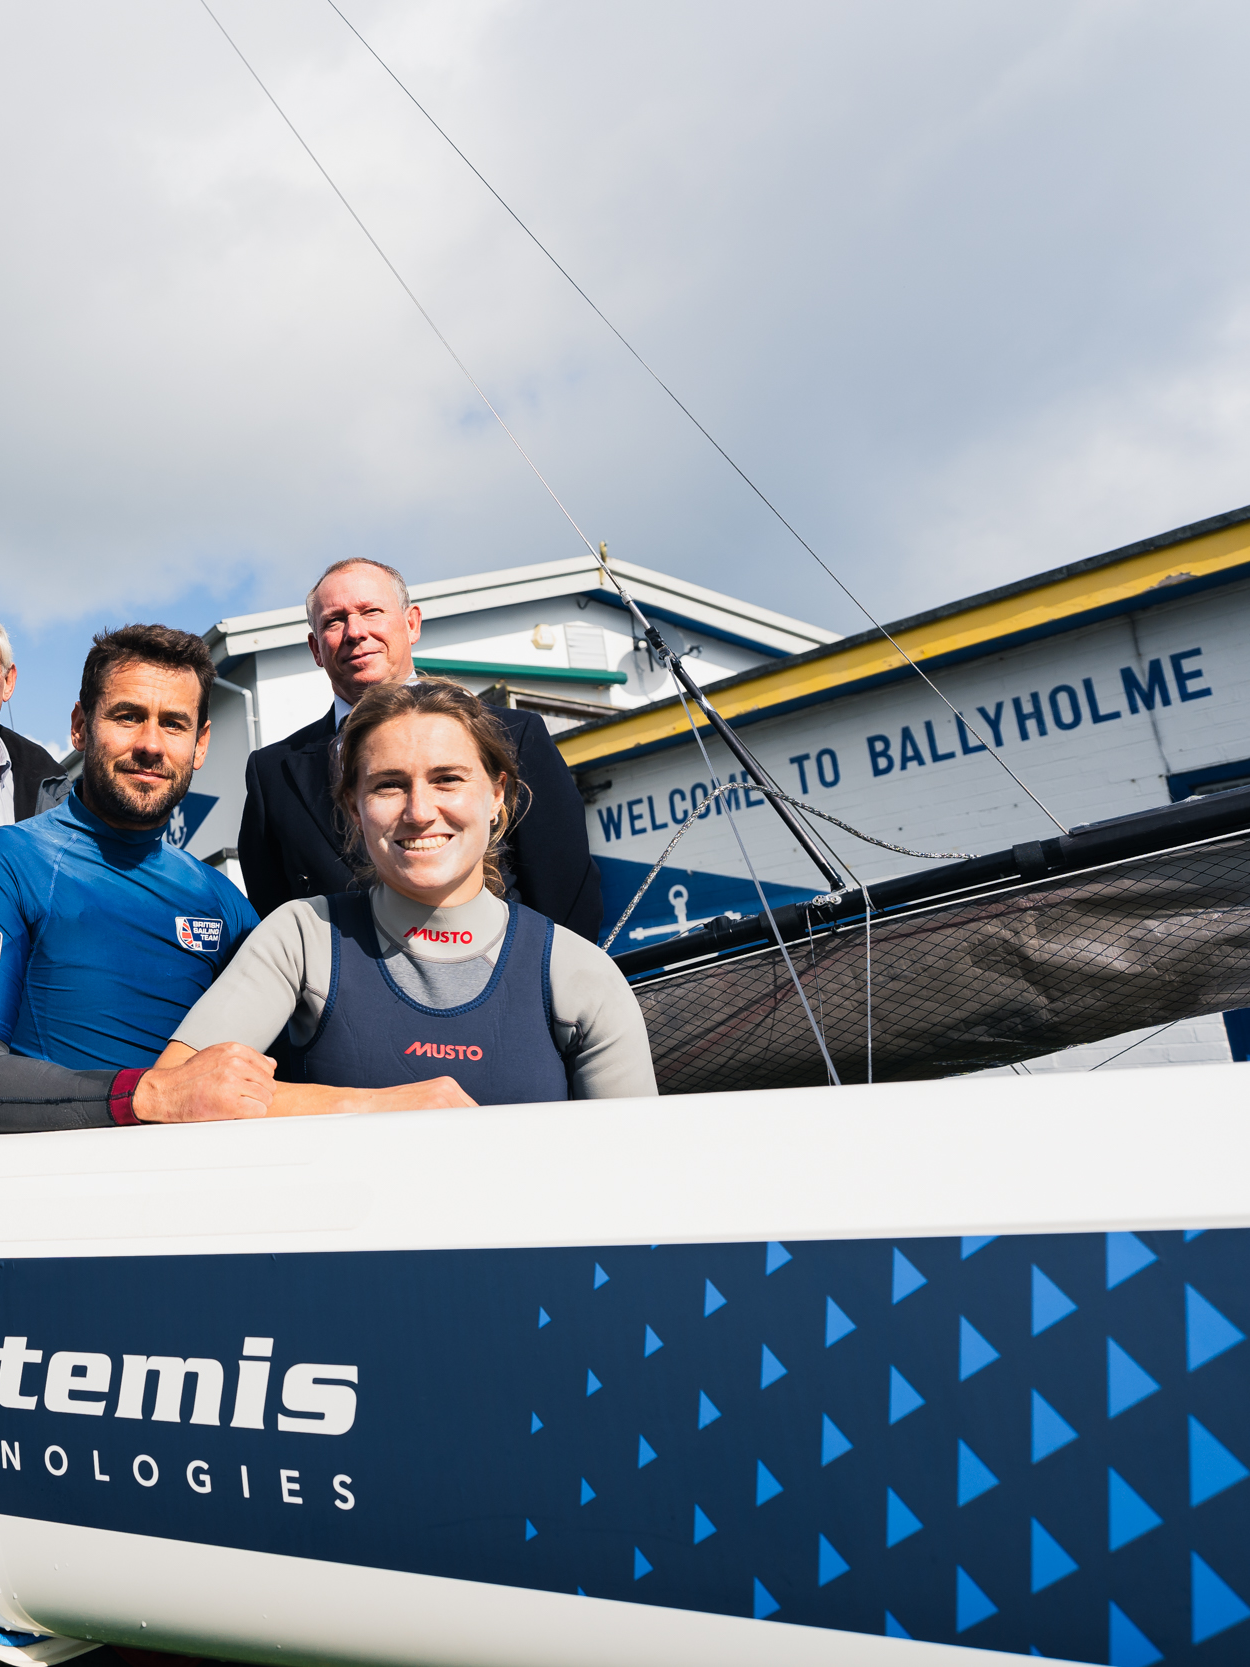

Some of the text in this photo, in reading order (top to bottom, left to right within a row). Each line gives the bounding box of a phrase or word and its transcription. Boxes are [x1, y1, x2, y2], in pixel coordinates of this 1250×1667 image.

[597, 647, 1213, 843] WELCOME TO BALLYHOLME
[193, 921, 220, 929] BRITISH
[403, 926, 473, 945] MUSTO
[404, 1041, 484, 1061] MUSTO
